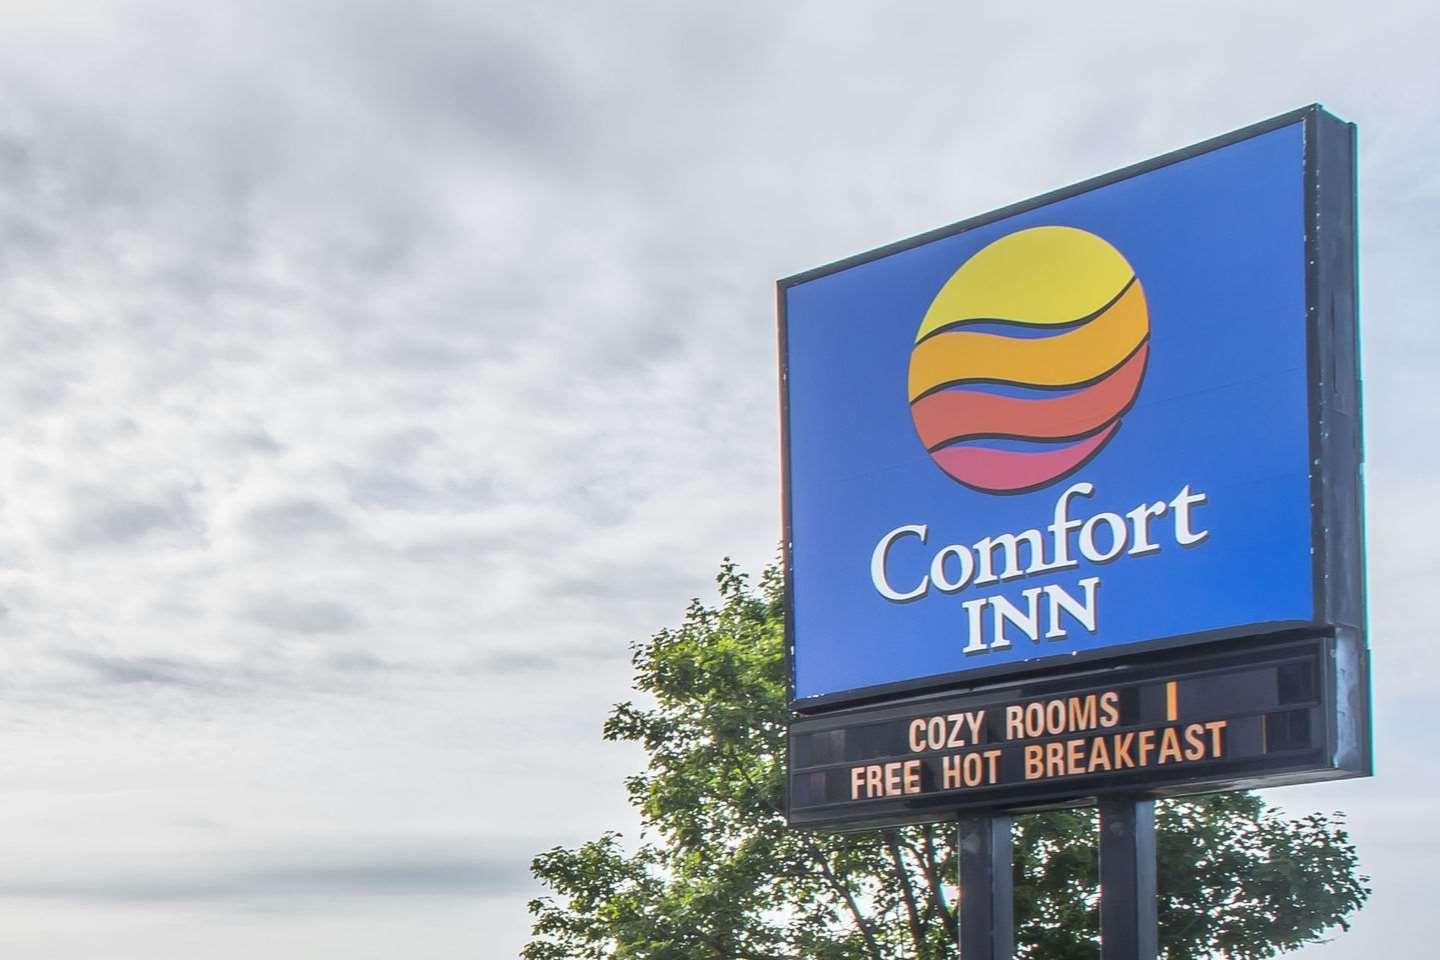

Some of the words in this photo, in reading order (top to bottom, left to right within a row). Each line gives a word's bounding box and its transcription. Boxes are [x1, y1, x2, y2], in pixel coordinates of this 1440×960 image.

[870, 482, 1209, 601] Comfort
[962, 576, 1100, 653] INN
[851, 759, 921, 800] FREE
[943, 750, 1002, 790] HOT
[1024, 720, 1227, 780] BREAKFAST
[909, 710, 985, 753] COZY
[1006, 691, 1120, 740] ROOMS
